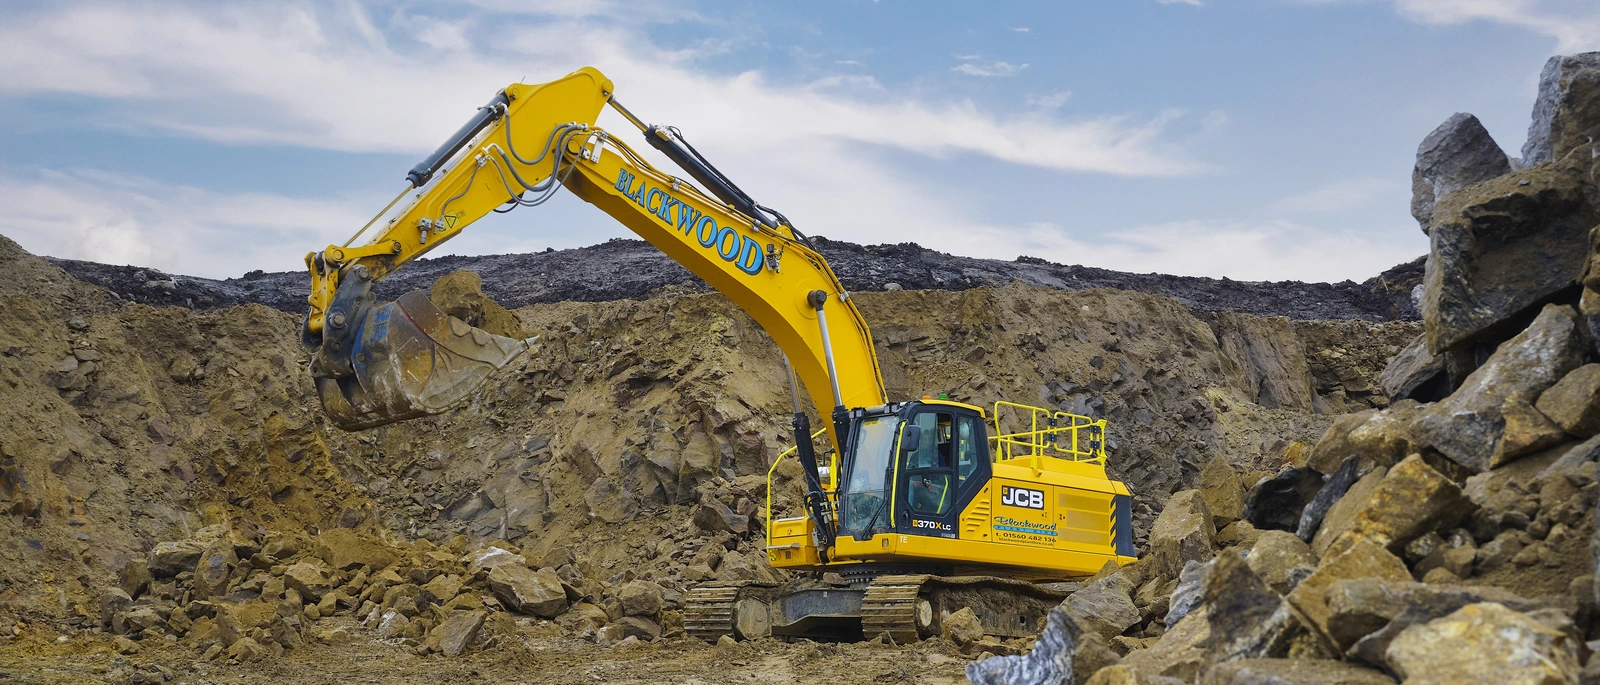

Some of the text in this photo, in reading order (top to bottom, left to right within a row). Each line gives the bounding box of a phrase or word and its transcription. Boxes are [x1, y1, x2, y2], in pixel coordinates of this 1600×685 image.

[614, 168, 764, 276] BLACKWOOD
[1003, 488, 1043, 509] JCB
[994, 516, 1057, 530] Blackwood
[1003, 532, 1026, 540] 01560
